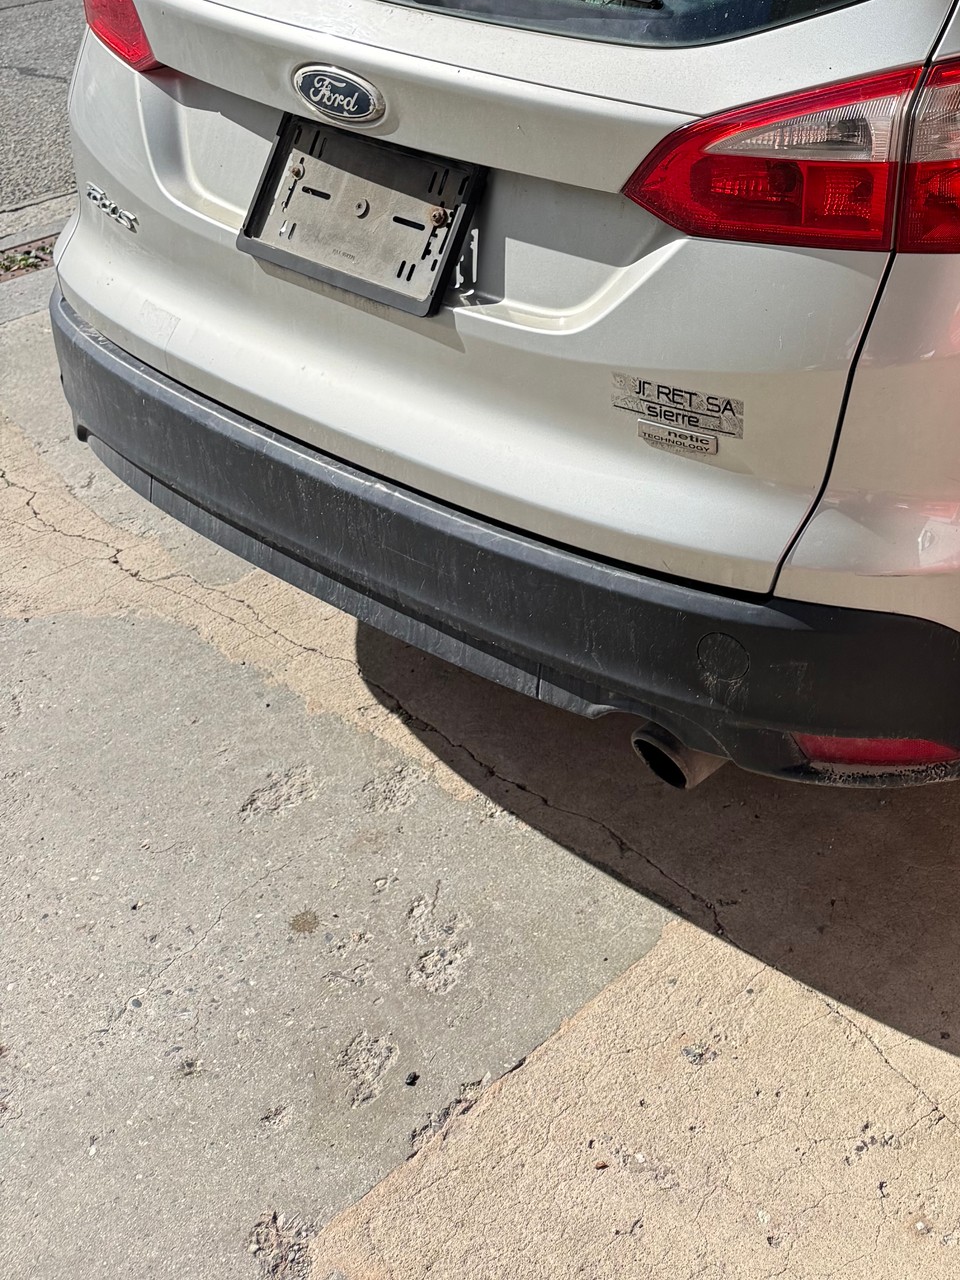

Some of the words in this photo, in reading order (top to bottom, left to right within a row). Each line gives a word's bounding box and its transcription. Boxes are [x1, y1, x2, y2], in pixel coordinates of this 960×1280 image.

[309, 75, 359, 112] Ford
[647, 405, 700, 428] sierre
[706, 395, 736, 417] SA
[642, 431, 710, 452] TECHNOLOGY
